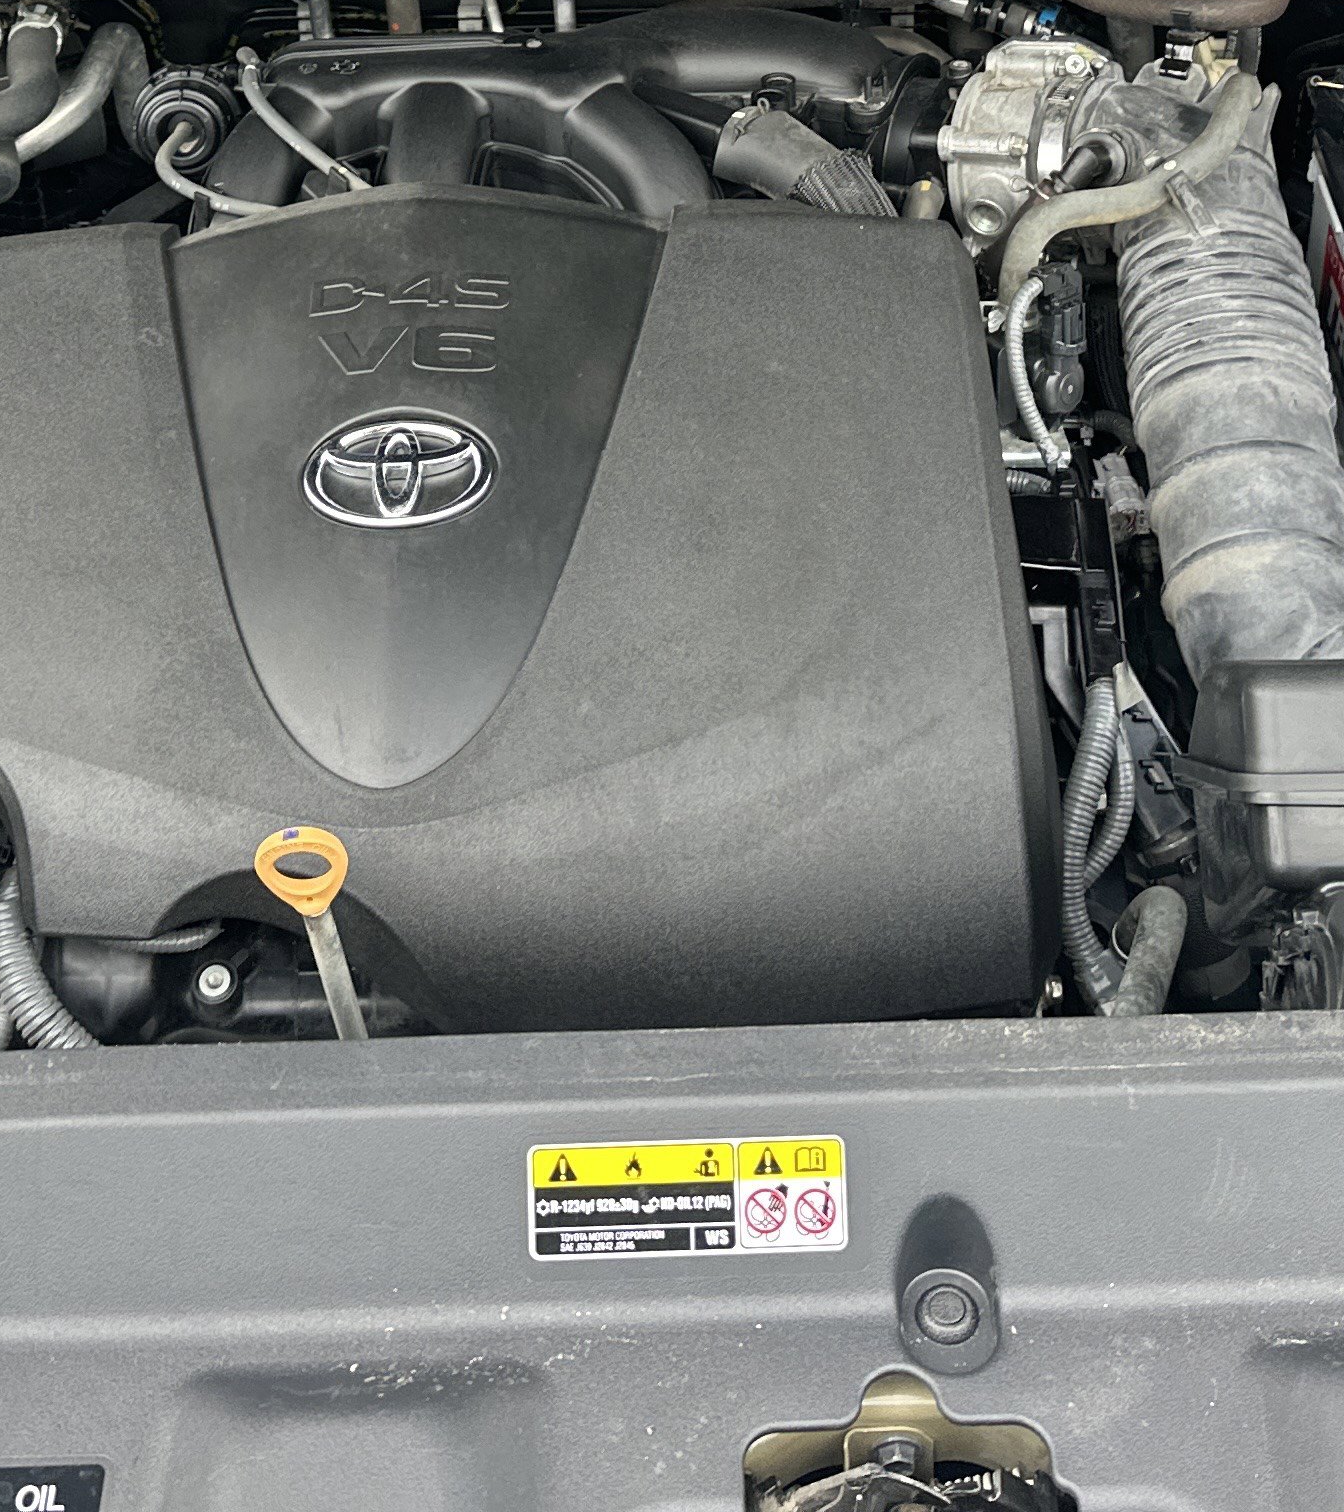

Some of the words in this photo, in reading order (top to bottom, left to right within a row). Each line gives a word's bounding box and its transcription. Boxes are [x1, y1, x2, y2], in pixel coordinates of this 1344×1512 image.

[309, 271, 510, 317] D-4S
[318, 325, 497, 375] V6
[559, 1232, 588, 1242] TOYOTA
[704, 1228, 730, 1246] WS
[14, 1484, 65, 1512] OIL
